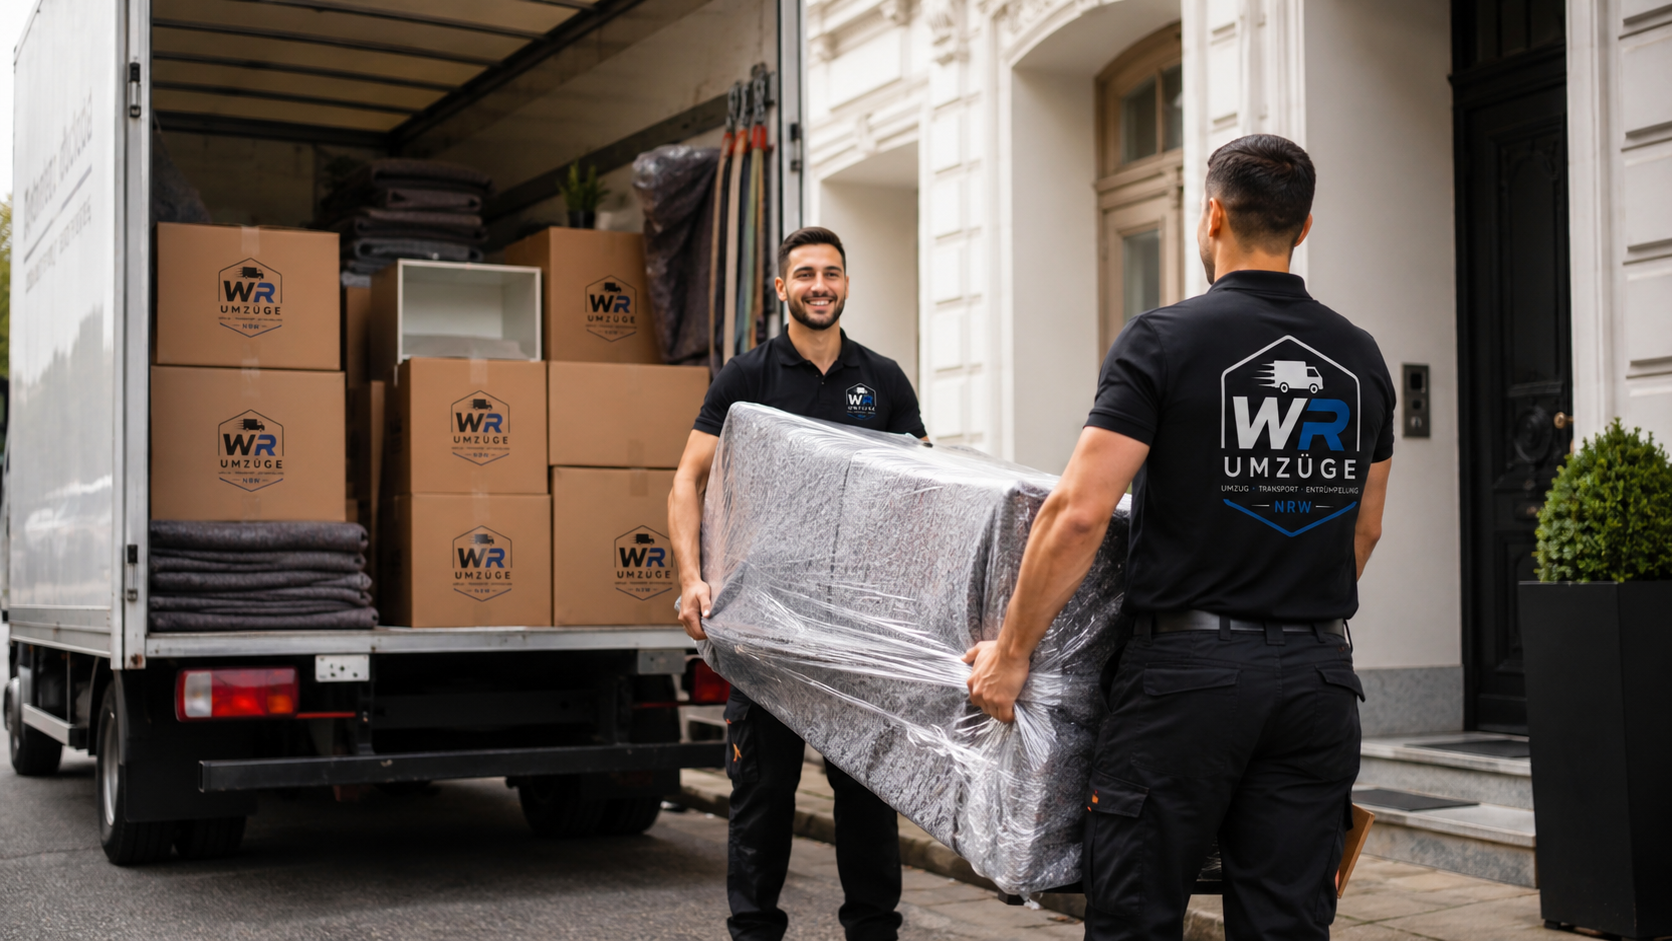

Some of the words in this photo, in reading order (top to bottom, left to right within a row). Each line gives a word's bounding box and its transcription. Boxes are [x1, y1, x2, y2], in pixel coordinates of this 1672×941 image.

[223, 280, 276, 304] WR
[589, 294, 631, 314] WR
[456, 412, 503, 434] WR
[1232, 396, 1350, 452] WR
[223, 433, 277, 456] WR
[1224, 453, 1357, 480] UMZÜGE
[1258, 485, 1299, 493] TRANSPORT
[1274, 500, 1312, 514] NRW
[457, 547, 506, 569] WR
[619, 547, 666, 568] WR
